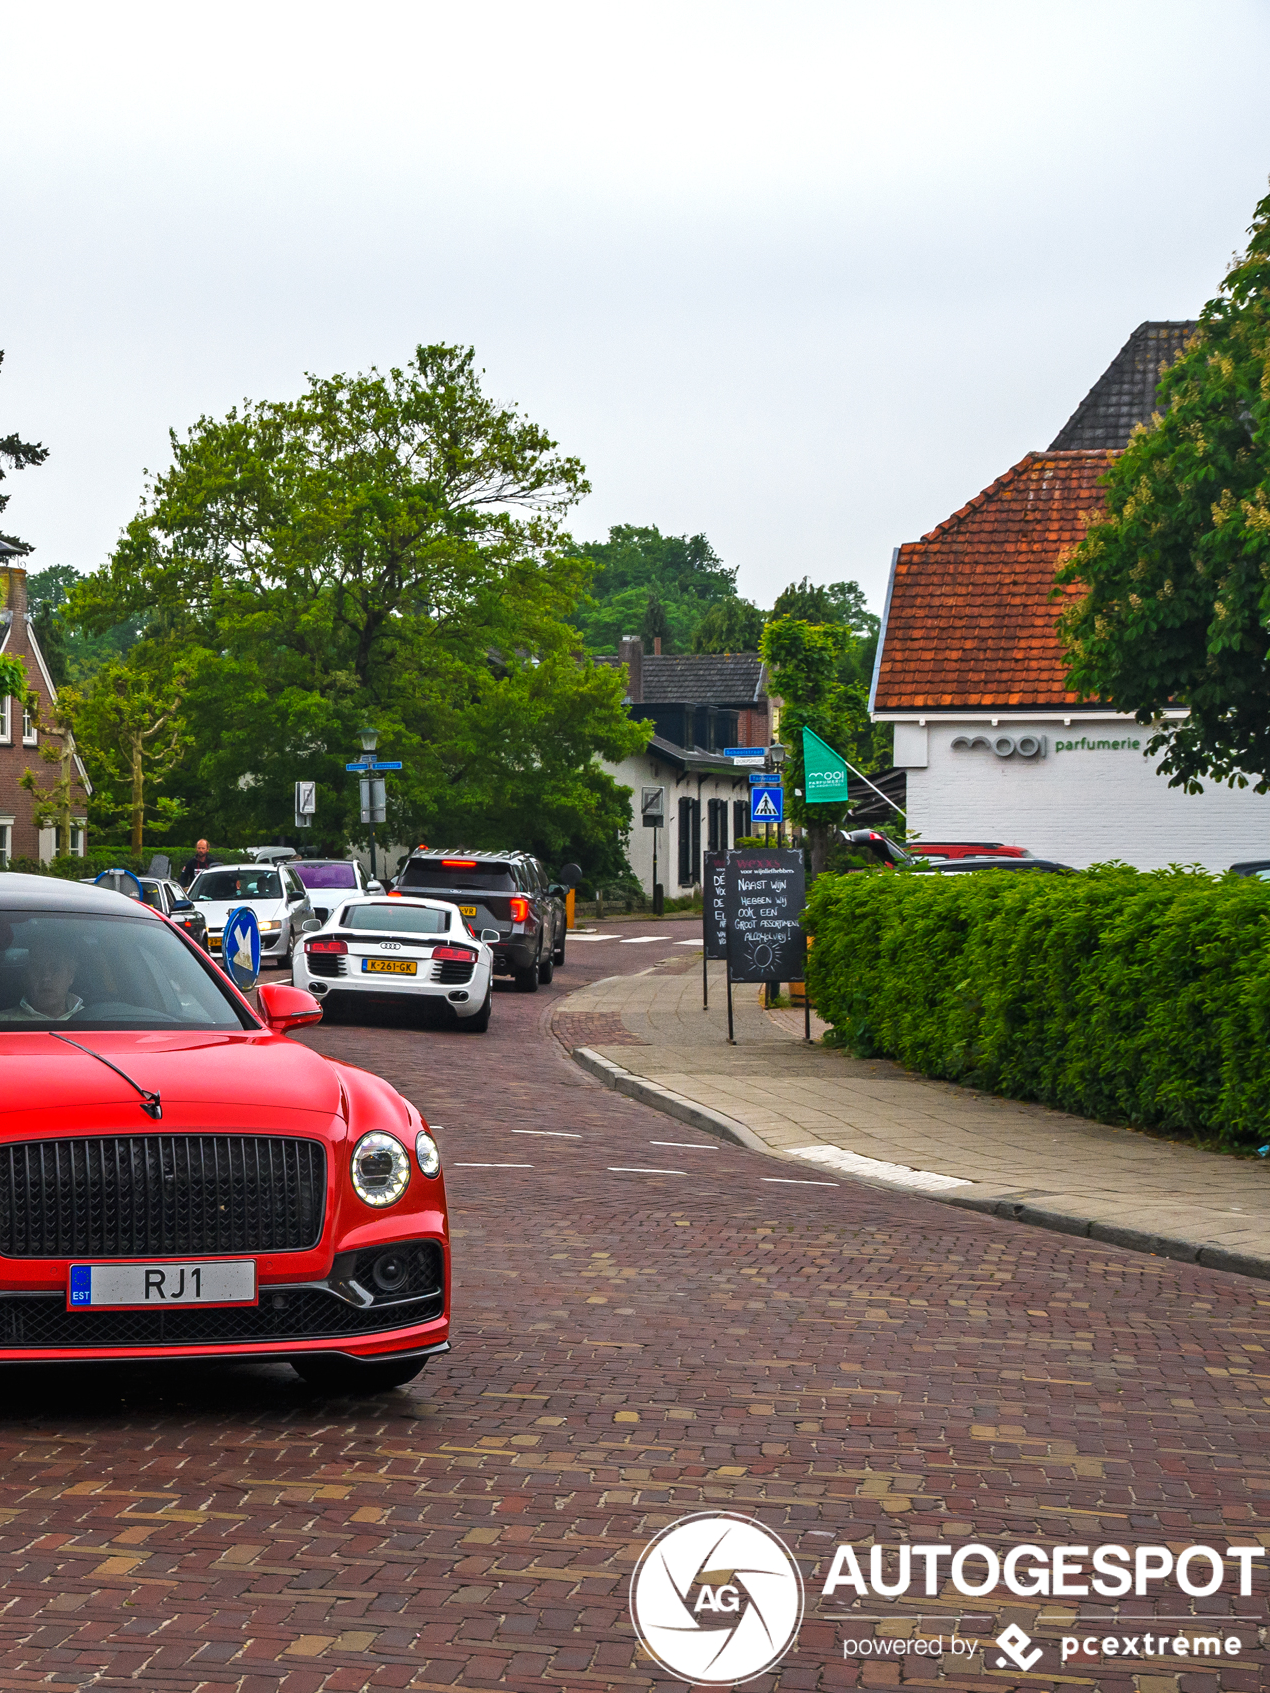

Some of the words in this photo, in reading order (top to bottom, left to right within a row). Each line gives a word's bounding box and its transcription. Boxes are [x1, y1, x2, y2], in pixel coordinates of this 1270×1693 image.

[950, 735, 1048, 760] mooi
[1055, 737, 1141, 753] parfumerie
[809, 771, 844, 782] mooi
[738, 878, 767, 891] NAAST
[741, 897, 772, 906] HEBBEN
[738, 907, 756, 919] OOK
[760, 907, 778, 917] EEN
[735, 919, 757, 930] GROOT
[370, 961, 412, 972] K-261-GK
[72, 1291, 90, 1300] EST
[144, 1267, 201, 1300] RJ1
